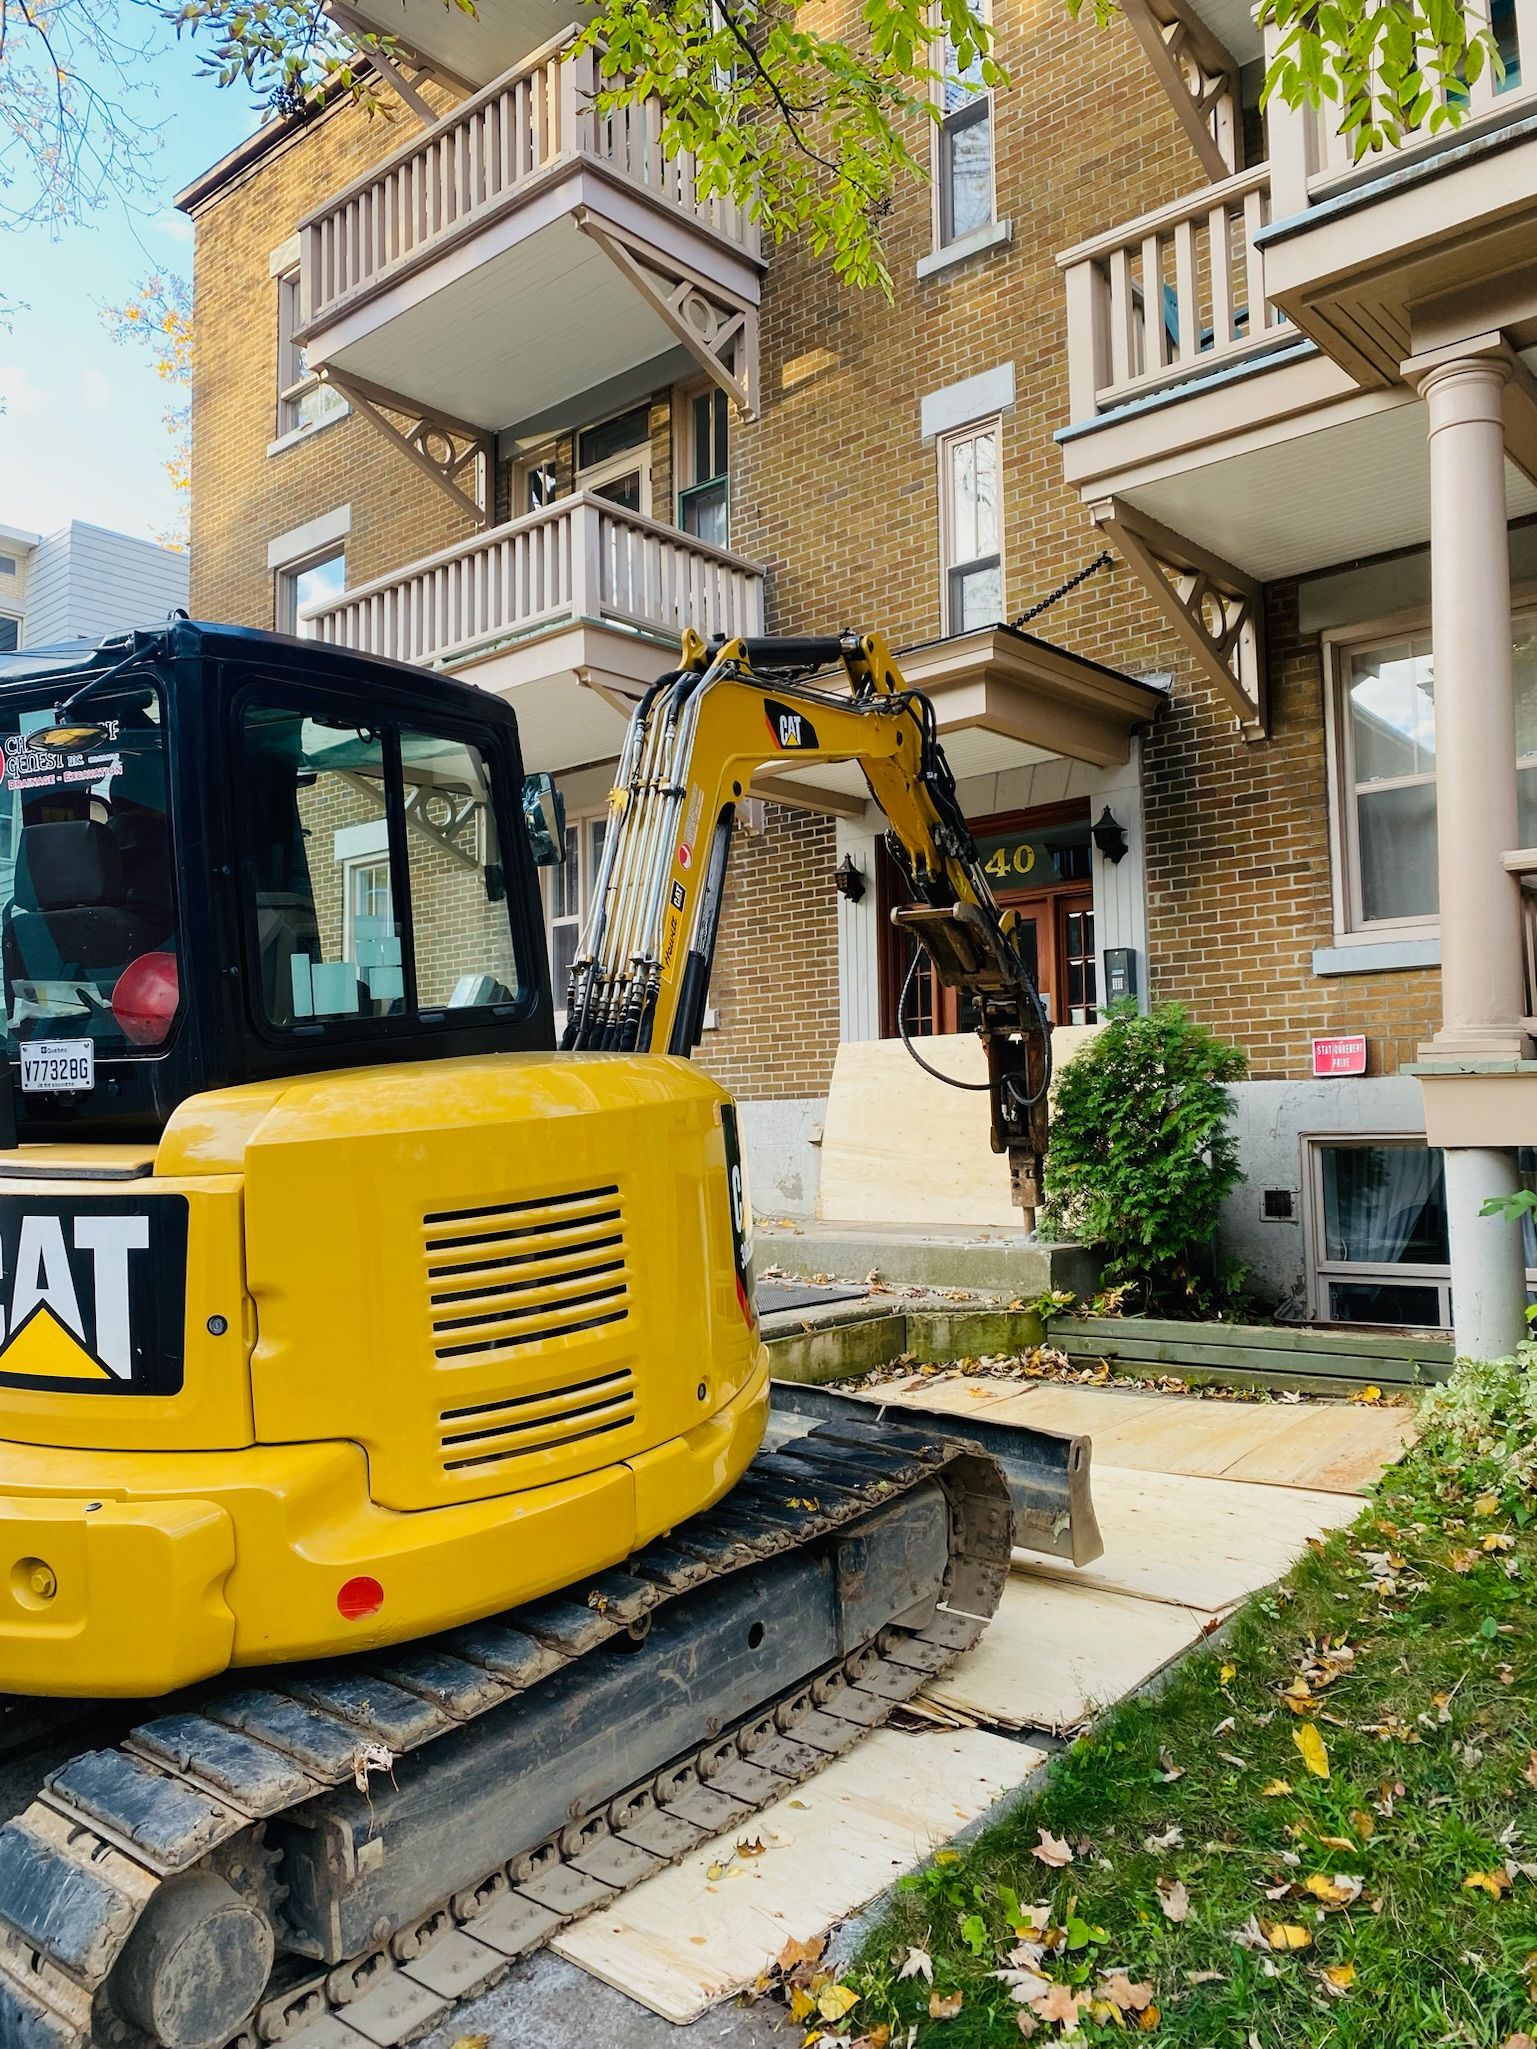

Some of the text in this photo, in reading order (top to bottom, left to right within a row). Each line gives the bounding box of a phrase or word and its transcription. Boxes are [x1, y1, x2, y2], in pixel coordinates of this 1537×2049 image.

[779, 715, 802, 746] CAT
[8, 774, 56, 790] DRAINAGE
[63, 765, 123, 783] EXCAVATION
[984, 844, 1035, 877] 40
[673, 884, 684, 908] CAT
[0, 1216, 149, 1379] AT
